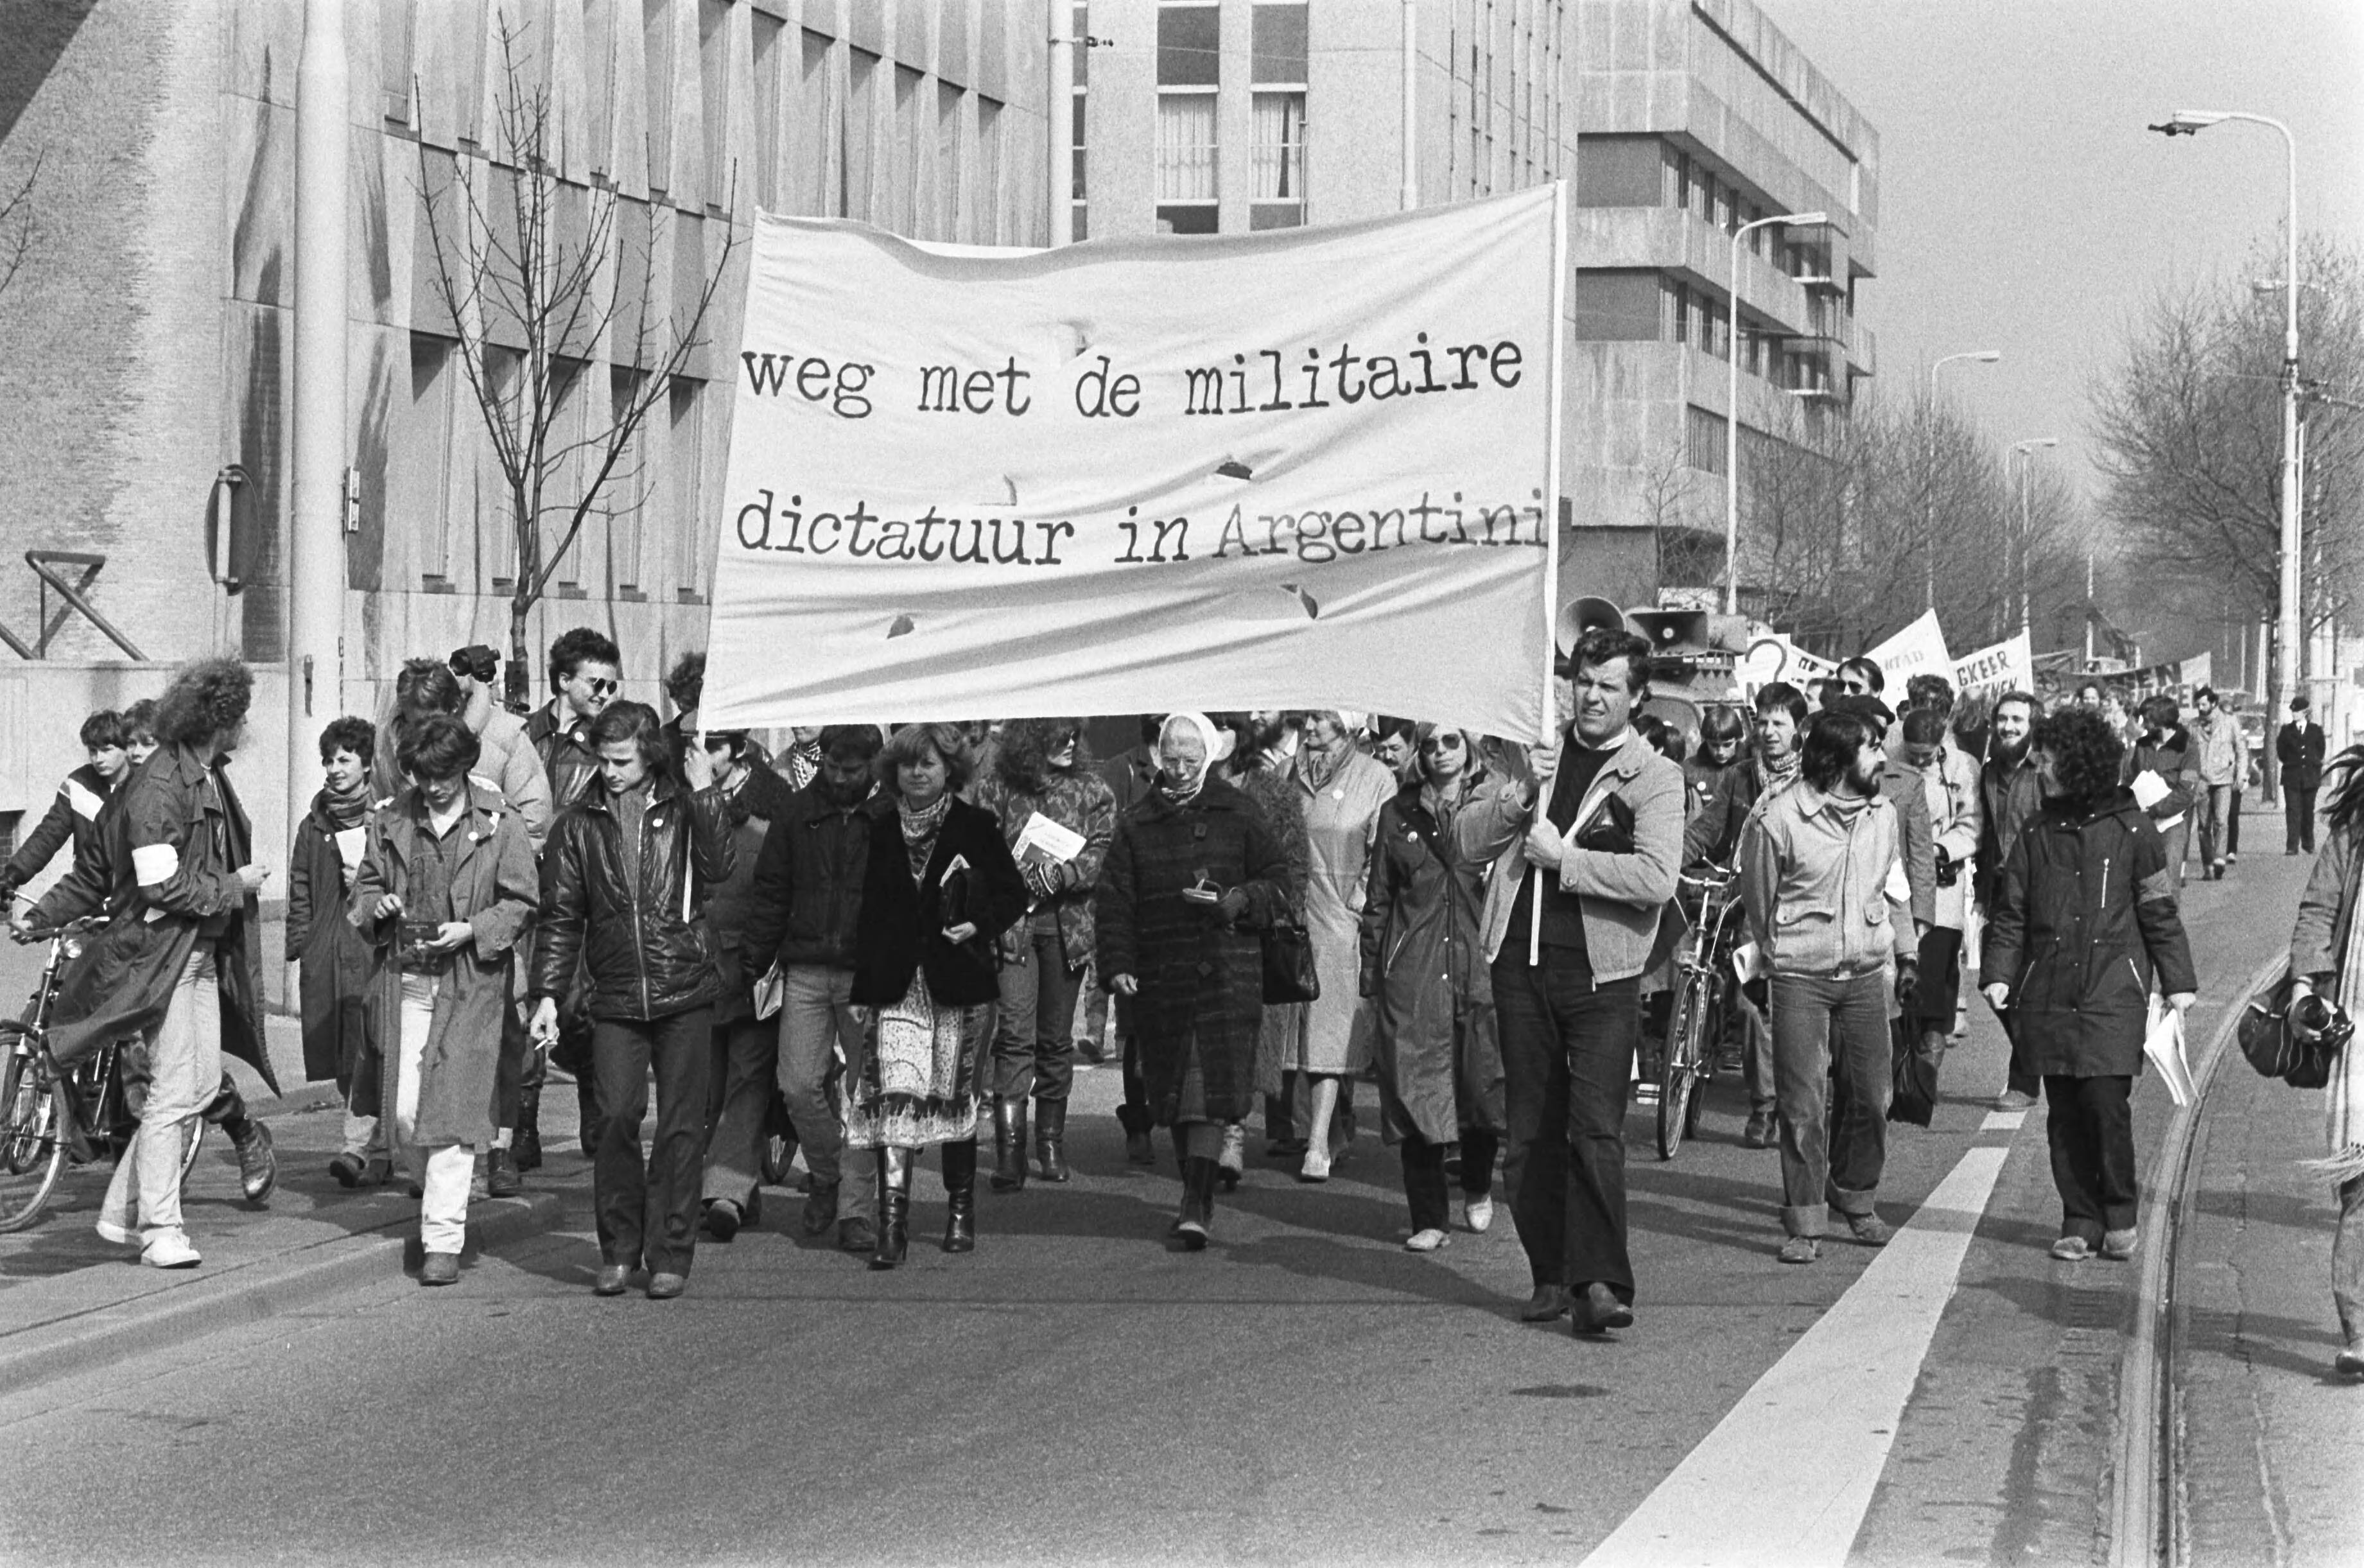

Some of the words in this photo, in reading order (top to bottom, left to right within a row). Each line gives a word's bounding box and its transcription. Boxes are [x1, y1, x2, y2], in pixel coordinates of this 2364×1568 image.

[740, 350, 876, 421] weg
[916, 354, 1032, 418] met
[1074, 354, 1142, 419] de
[1183, 331, 1524, 417] militaire
[736, 487, 1076, 566] dictatuur
[1113, 498, 1190, 564] in
